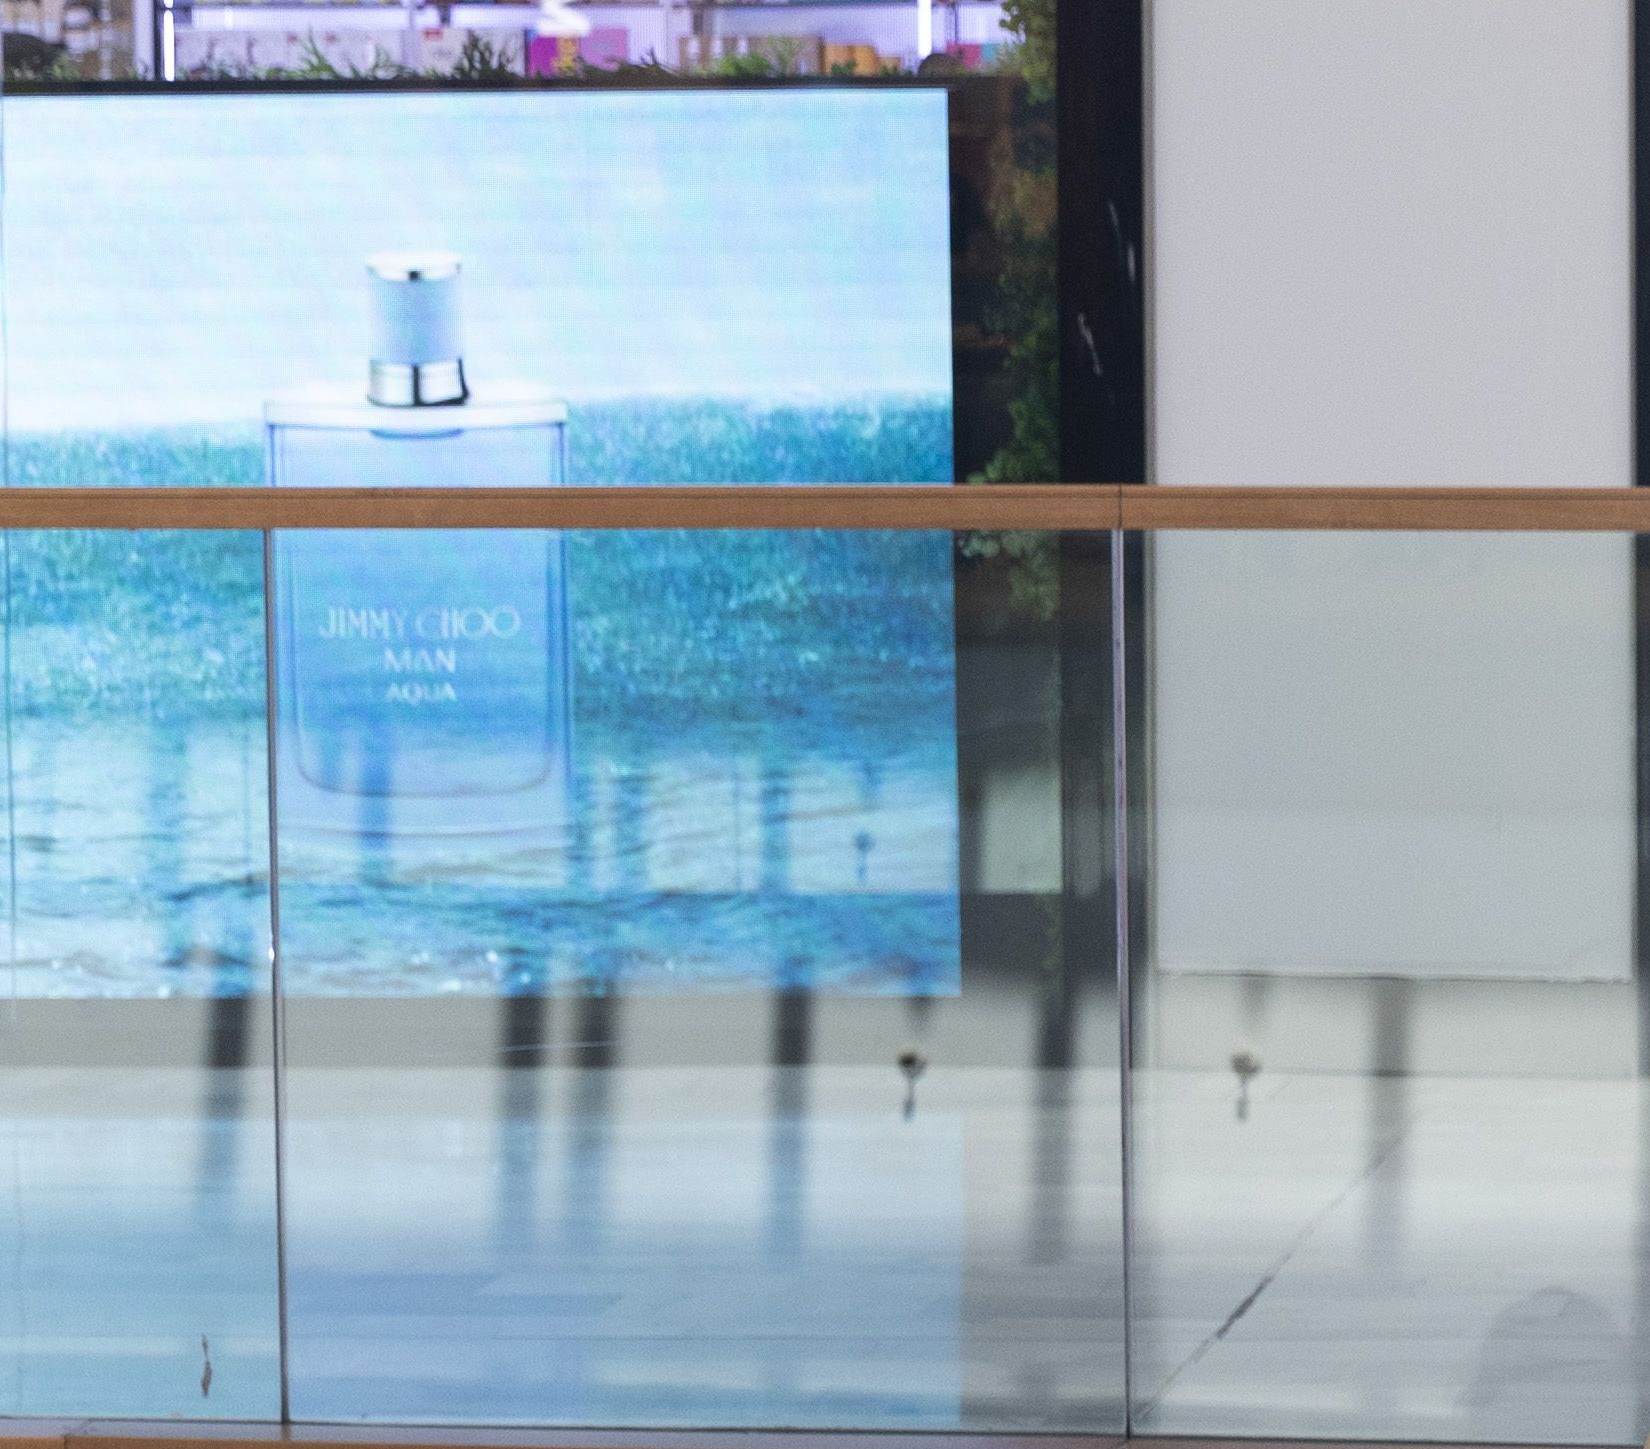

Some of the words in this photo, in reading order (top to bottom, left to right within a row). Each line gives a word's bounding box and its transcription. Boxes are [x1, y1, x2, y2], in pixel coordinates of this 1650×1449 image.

[318, 606, 408, 641] JIMMY
[414, 606, 521, 641] CHOO
[383, 648, 457, 674] MAN
[385, 681, 459, 703] AQUA
